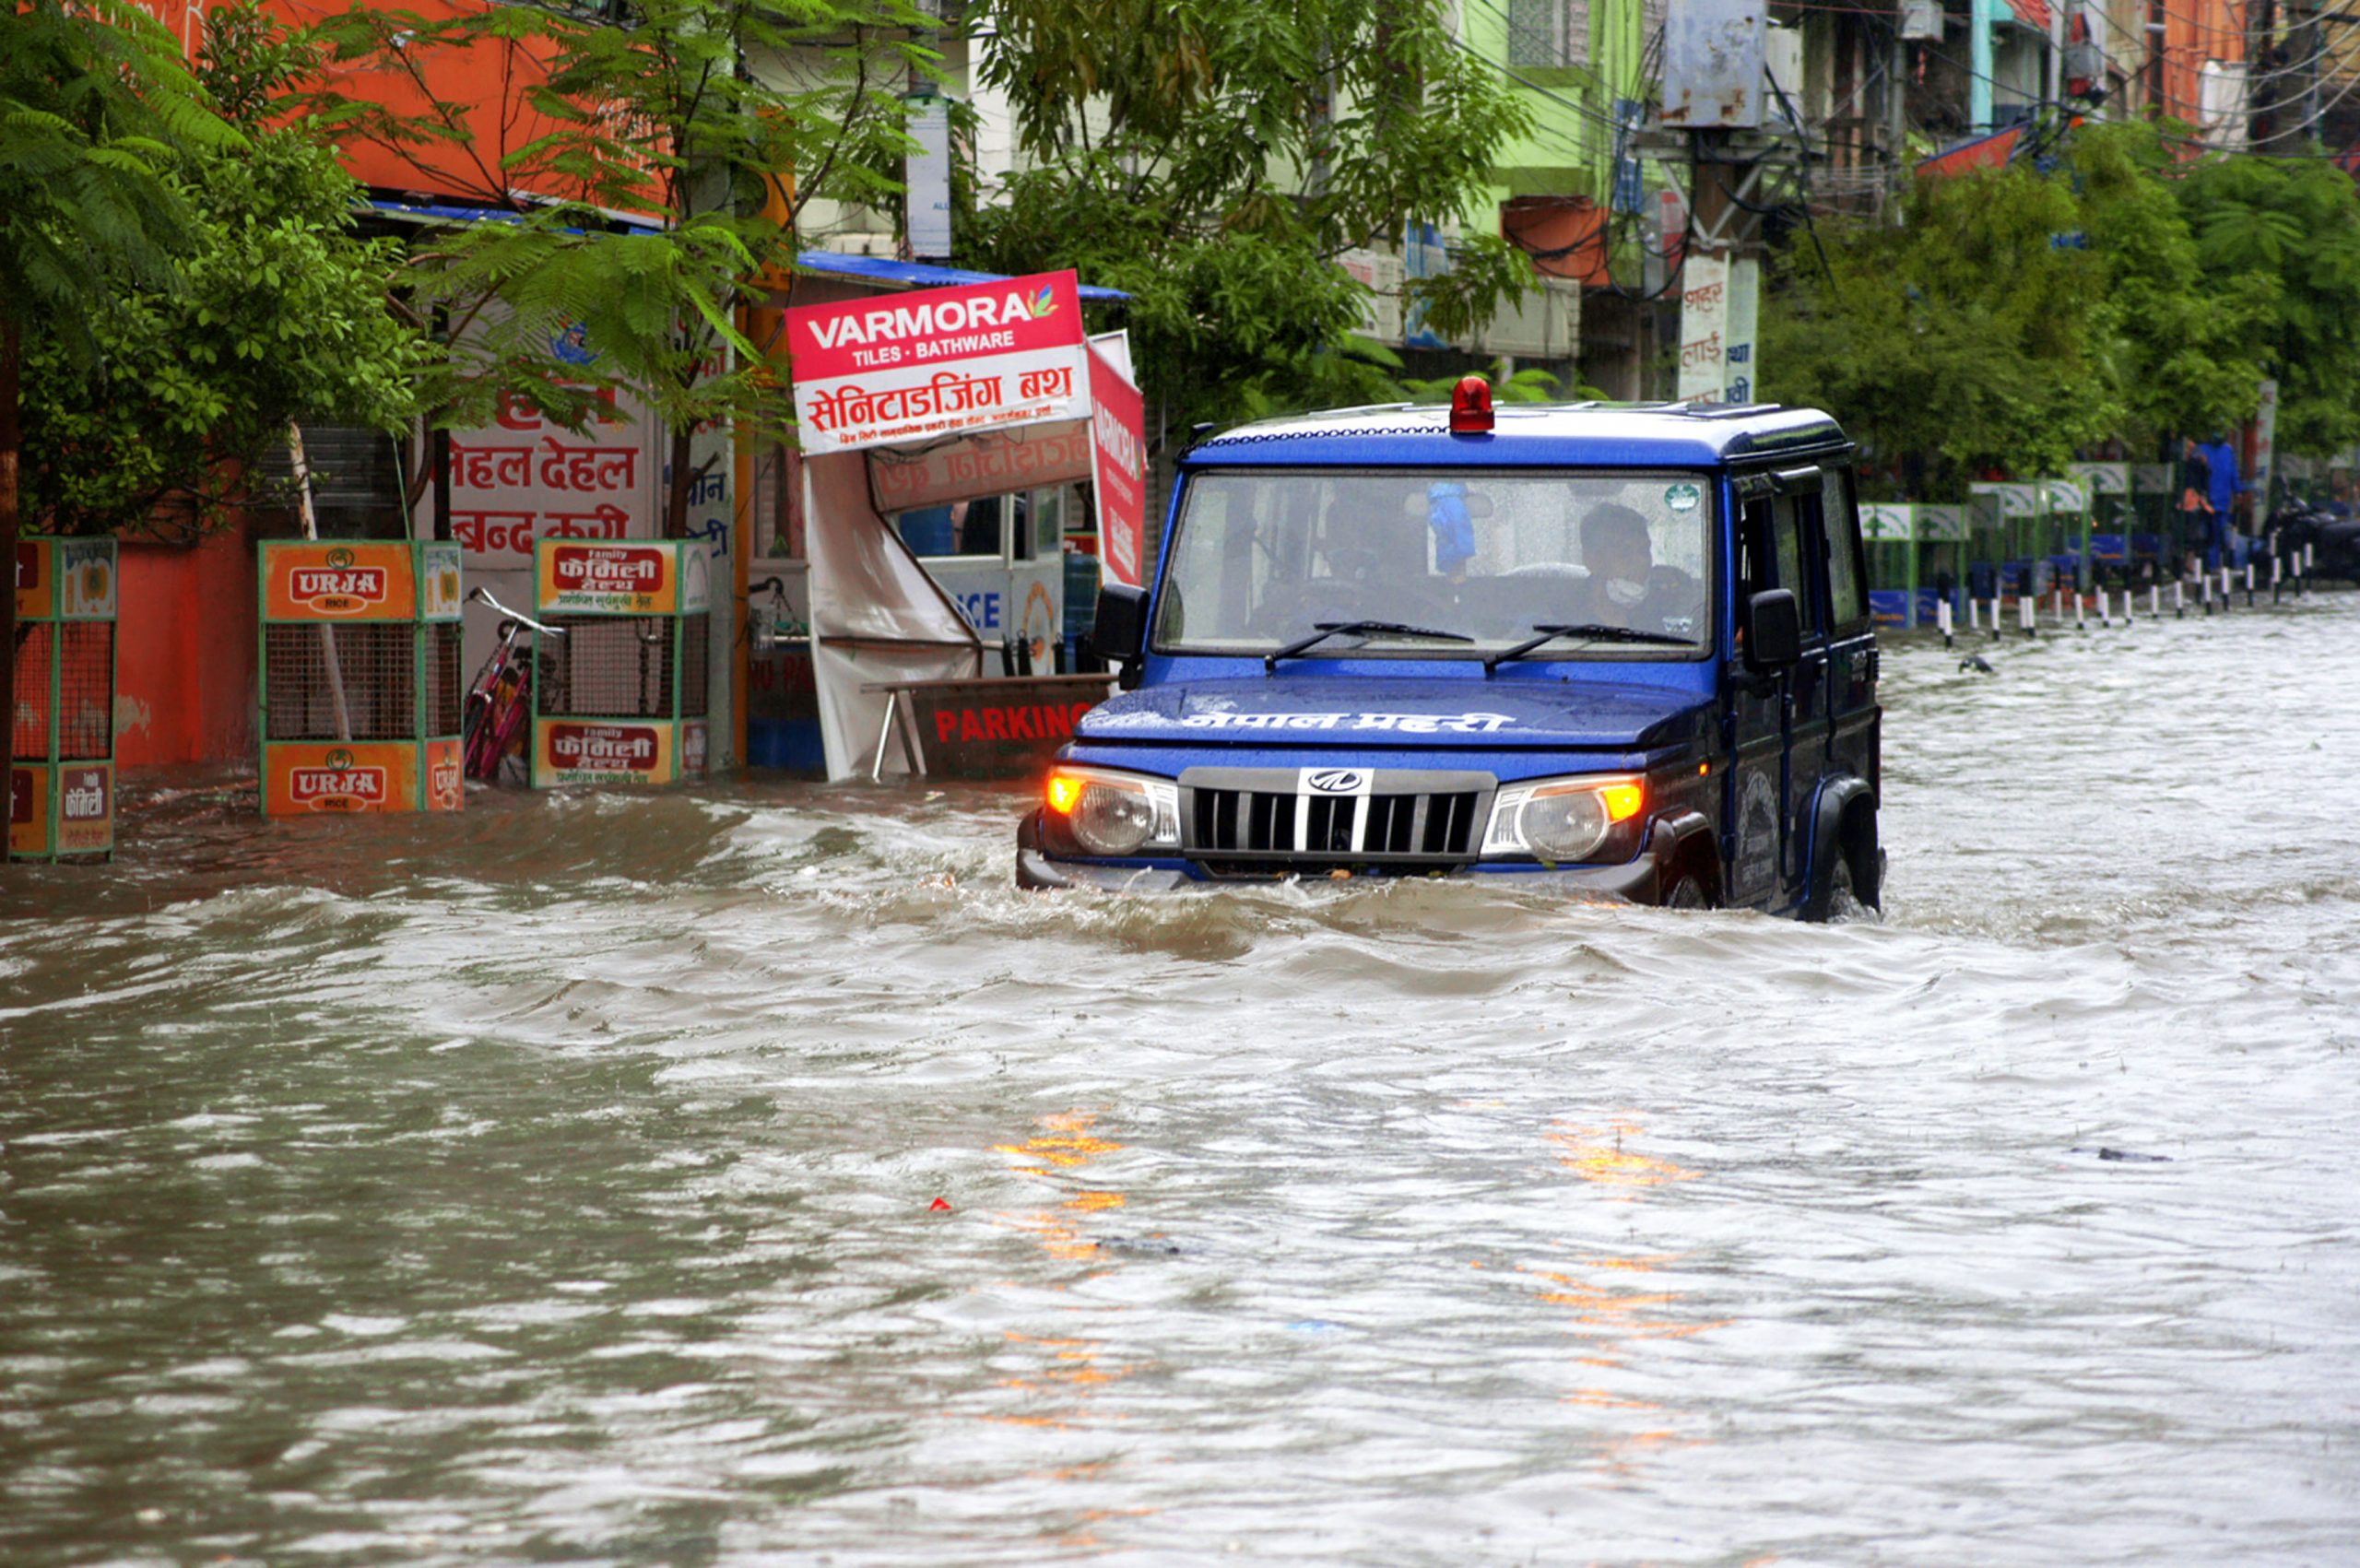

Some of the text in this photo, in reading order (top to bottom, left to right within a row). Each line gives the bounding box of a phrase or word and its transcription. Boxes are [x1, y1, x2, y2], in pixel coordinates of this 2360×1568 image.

[808, 292, 1031, 349] VARMORA
[853, 331, 1014, 367] TILES BATHWARE
[540, 436, 639, 492] देहल
[299, 572, 377, 593] URJA
[324, 599, 349, 608] RICE
[1181, 712, 1351, 731] नेपाल
[299, 772, 378, 793] URJA
